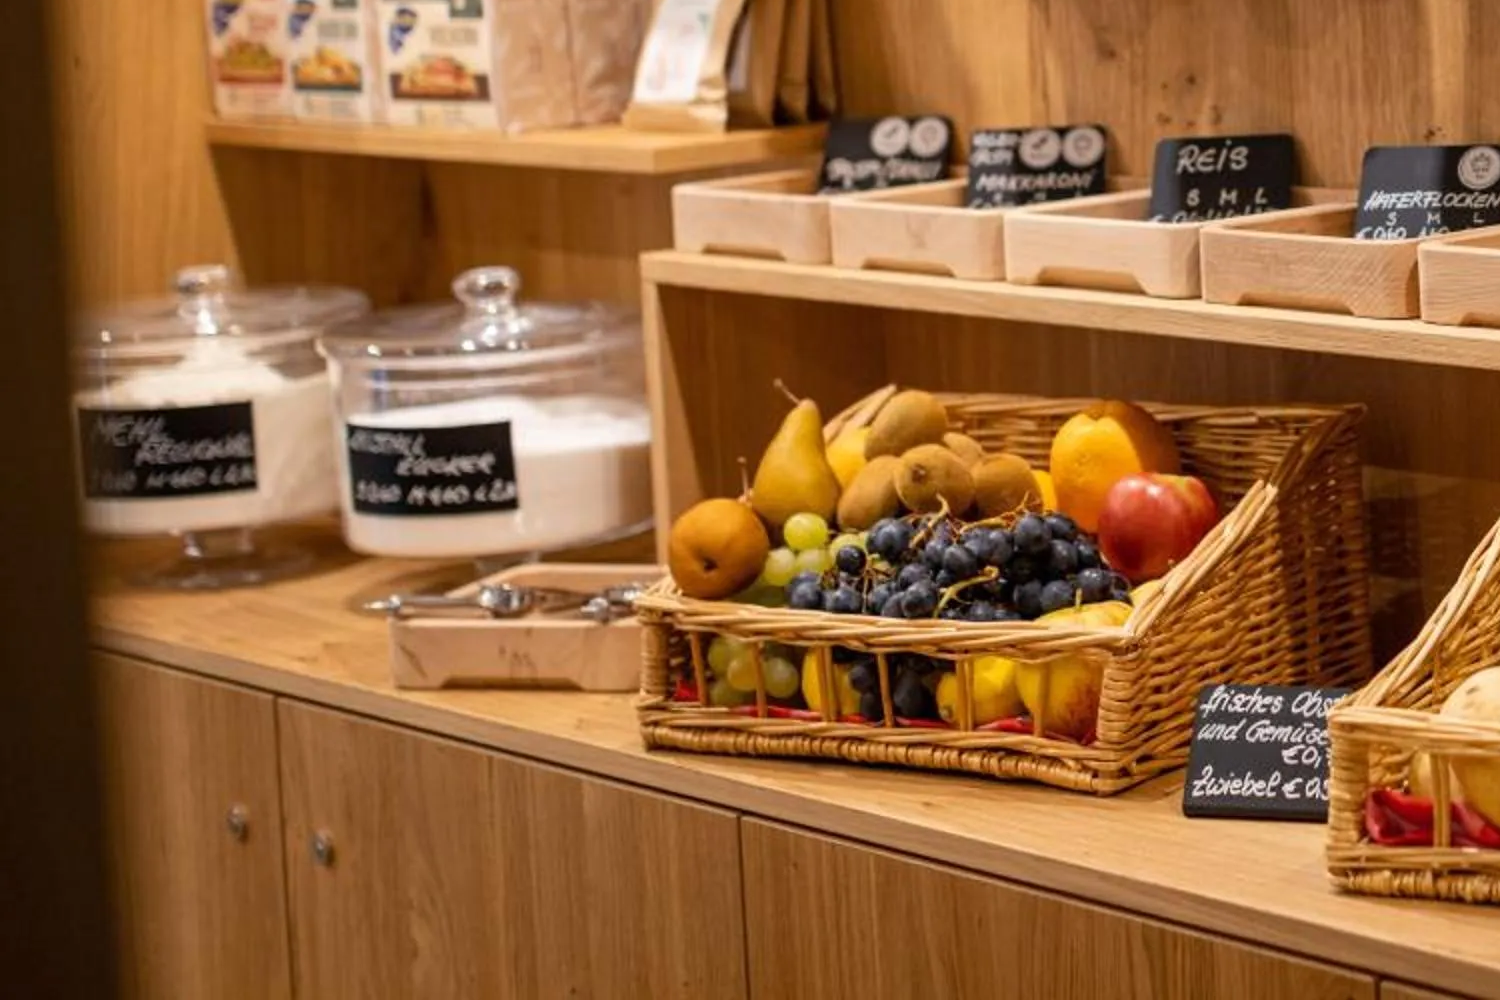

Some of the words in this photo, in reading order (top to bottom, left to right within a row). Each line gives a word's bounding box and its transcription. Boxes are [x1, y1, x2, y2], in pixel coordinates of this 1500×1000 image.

[1187, 188, 1200, 206] S
[1219, 188, 1238, 206] M
[1255, 187, 1268, 204] L
[1386, 212, 1398, 227] S
[1427, 212, 1441, 225] M
[1473, 212, 1485, 223] L
[1200, 684, 1284, 718] frisches
[1197, 717, 1247, 741] und
[1192, 763, 1281, 799] Zwiebel
